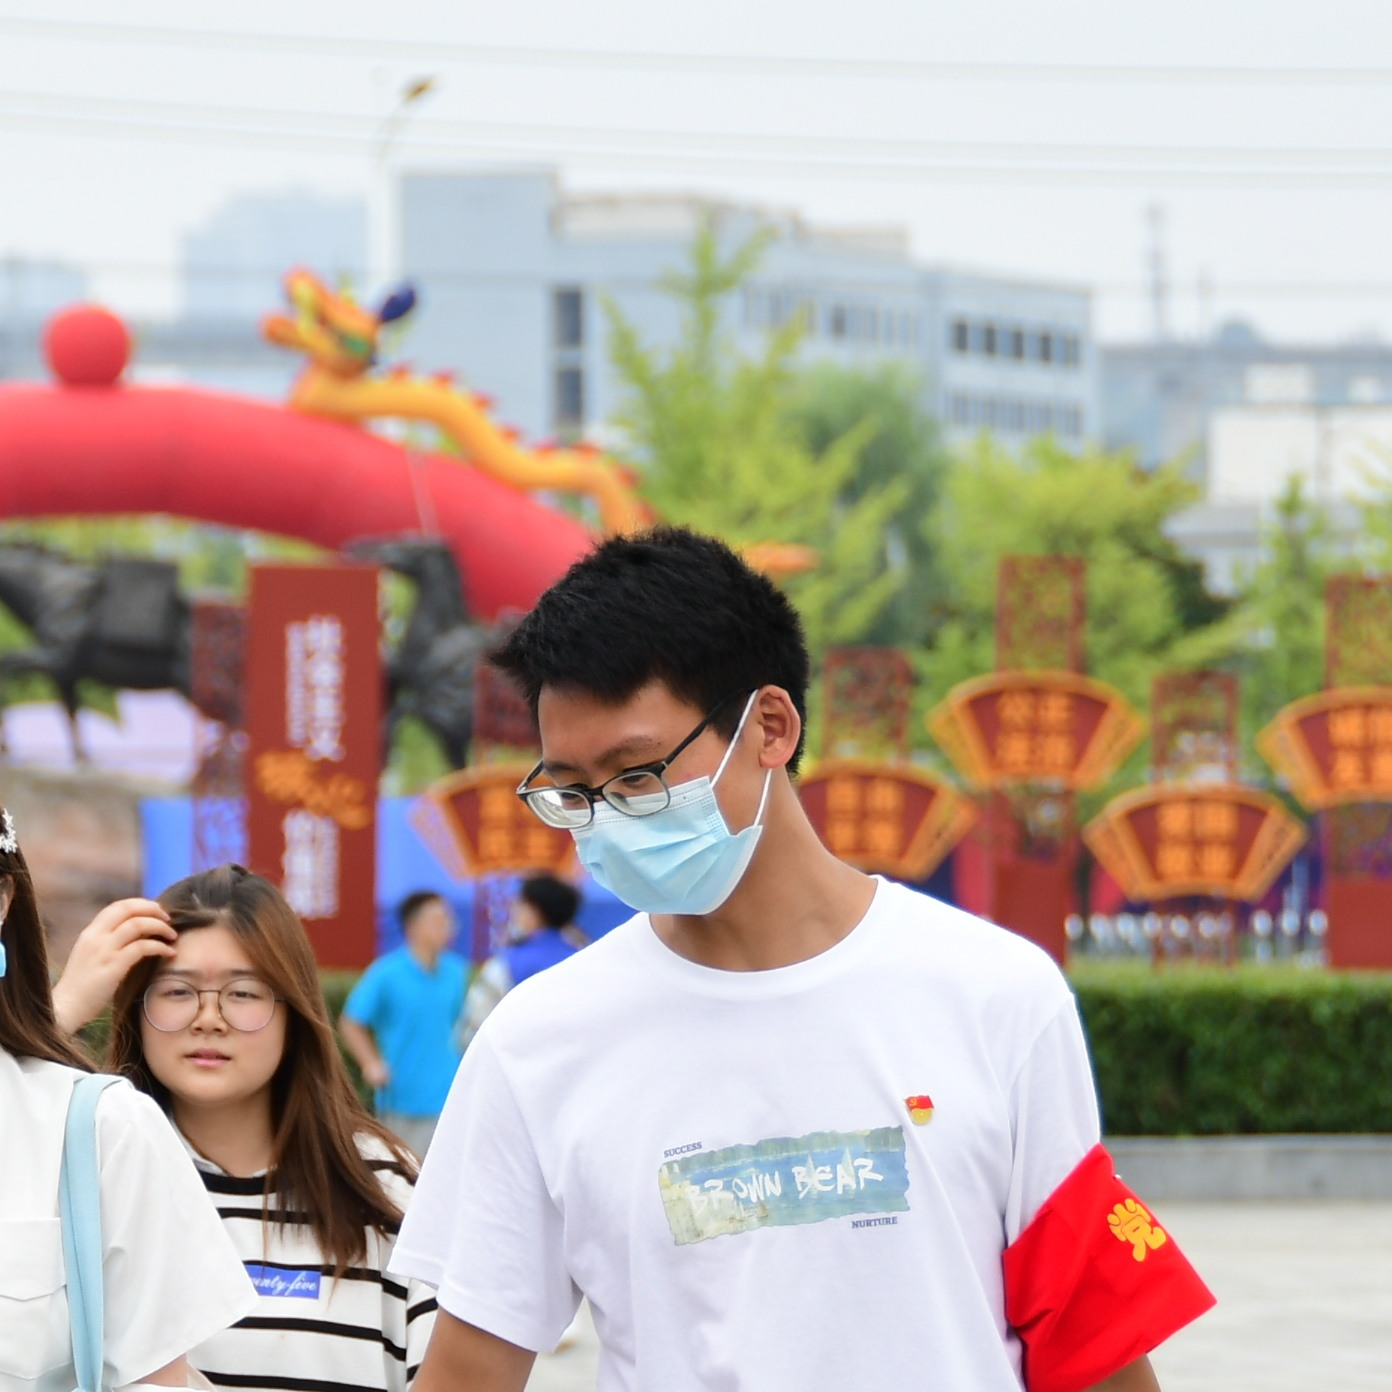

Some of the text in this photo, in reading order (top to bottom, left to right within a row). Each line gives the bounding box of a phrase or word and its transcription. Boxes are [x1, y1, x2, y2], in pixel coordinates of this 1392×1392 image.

[663, 1141, 702, 1158] SUCCESS
[685, 1157, 884, 1214] BROWN BEAR
[851, 1216, 898, 1229] NURTURE
[1107, 1198, 1166, 1262] 党
